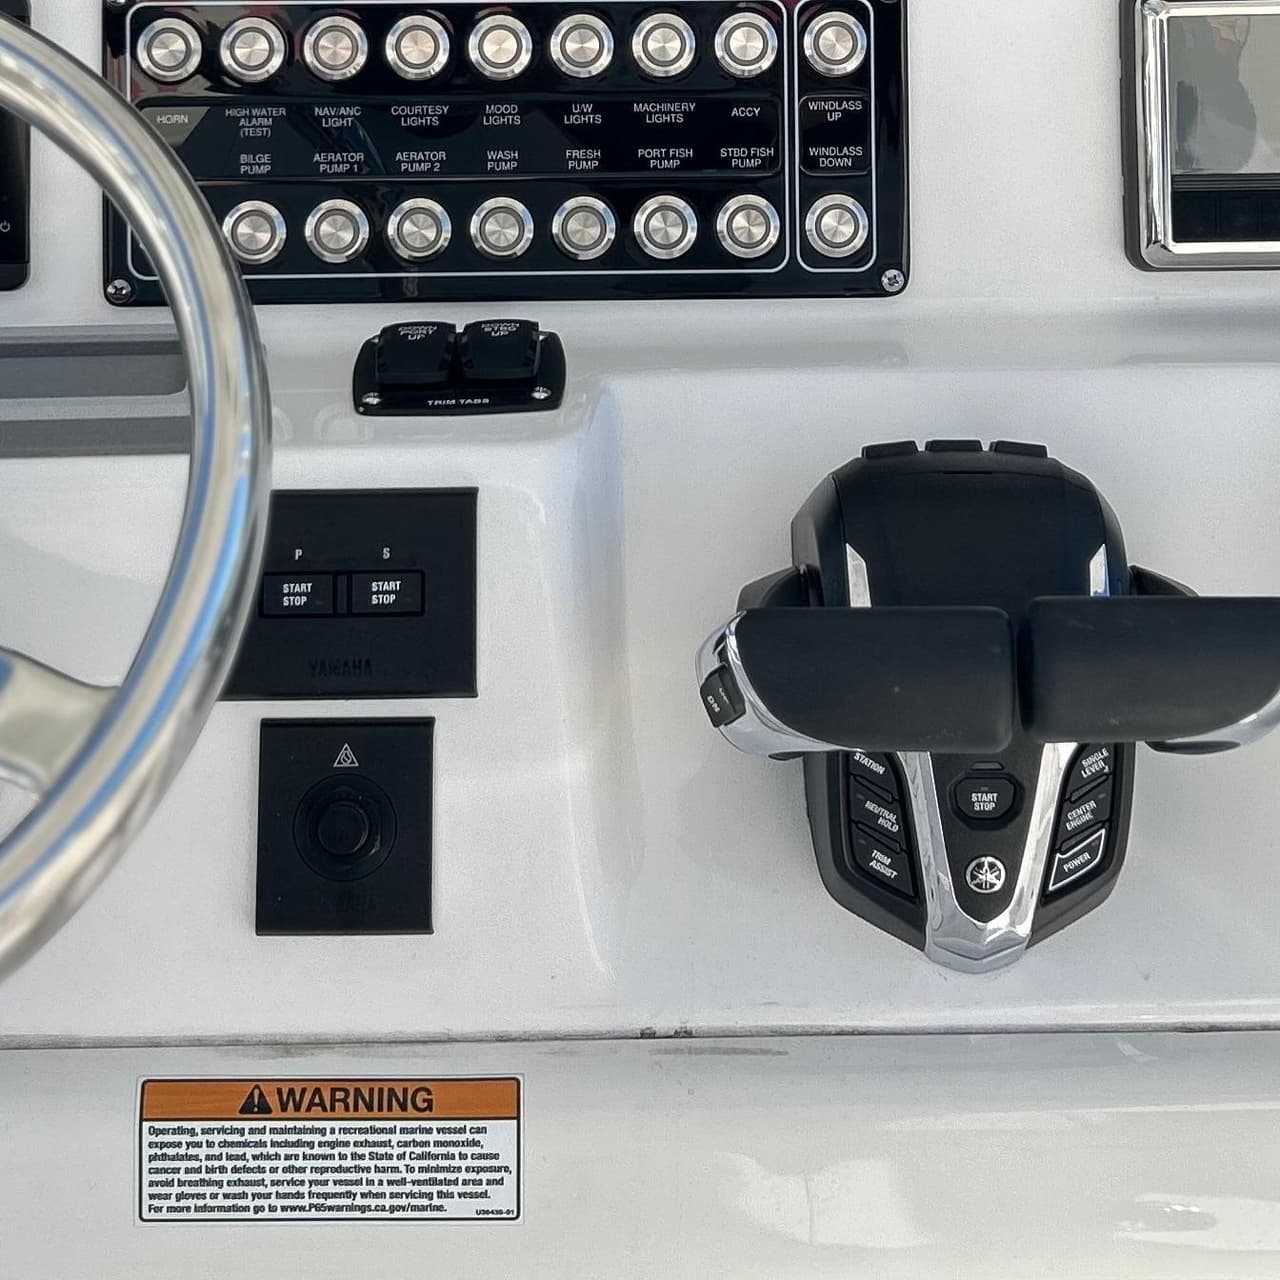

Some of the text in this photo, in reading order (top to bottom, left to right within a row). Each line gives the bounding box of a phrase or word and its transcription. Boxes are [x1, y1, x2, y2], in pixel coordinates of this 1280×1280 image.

[314, 106, 361, 116] NAV/ANC
[391, 104, 449, 116] COURTESY
[486, 104, 518, 115] MOOD
[572, 103, 593, 114] U/W
[633, 103, 696, 113] MACHINERY
[808, 101, 862, 111] WINDLASS
[225, 107, 286, 117] HIGH WATER
[731, 107, 761, 118] ACCY
[827, 111, 842, 122] UP
[157, 113, 189, 124] HORN
[239, 117, 273, 127] ALARM
[322, 117, 353, 127] LIGHT
[401, 115, 439, 127] LIGHTS
[483, 115, 521, 125] LIGHTS
[563, 114, 602, 125] LIGHTS
[646, 113, 684, 124] LIGHTS
[240, 127, 271, 138] (TEST)
[395, 151, 447, 162] AERATOR
[487, 150, 518, 161] WASH
[565, 149, 601, 160] FRESH
[638, 148, 693, 159] PORT FISH
[720, 147, 774, 158] STBD FISH
[809, 146, 863, 157] WINDLASS
[240, 153, 272, 164] BILGE
[313, 152, 364, 163] AERATOR
[819, 157, 852, 168] DOWN
[320, 163, 359, 174] PUMP 1
[401, 162, 441, 172] PUMP 2
[487, 161, 518, 171] PUMP
[568, 160, 599, 170] PUMP
[649, 159, 681, 169] PUMP
[731, 158, 762, 169] PUMP
[240, 164, 271, 175] PUMP
[295, 549, 303, 560] P
[382, 547, 391, 559] S
[283, 583, 313, 593] START
[371, 581, 402, 592] START
[283, 595, 307, 606] STOP
[371, 594, 396, 605] STOP
[853, 752, 885, 775] STATION
[1081, 748, 1109, 768] SINGLE
[1080, 759, 1106, 778] LEVER
[971, 793, 998, 803] START
[974, 801, 996, 811] STOP
[1067, 800, 1097, 820] CENTER
[865, 800, 897, 824] NEUTRAL
[878, 814, 900, 833] HOLD
[1065, 812, 1094, 831] ENGINE
[871, 849, 892, 864] TRIM
[1063, 851, 1091, 873] POWER
[869, 858, 898, 879] ASSIST
[277, 1087, 434, 1113] WARNING
[148, 1125, 199, 1138] Operating,
[200, 1125, 245, 1137] servicing
[247, 1125, 266, 1135] and
[269, 1125, 326, 1137] maintaining
[338, 1125, 396, 1135] recreational
[399, 1125, 434, 1135] marine
[436, 1125, 467, 1135] vessel
[469, 1126, 487, 1135] can
[148, 1202, 447, 1215] For more information go to www.P65warnings.ca.gov/marine.
